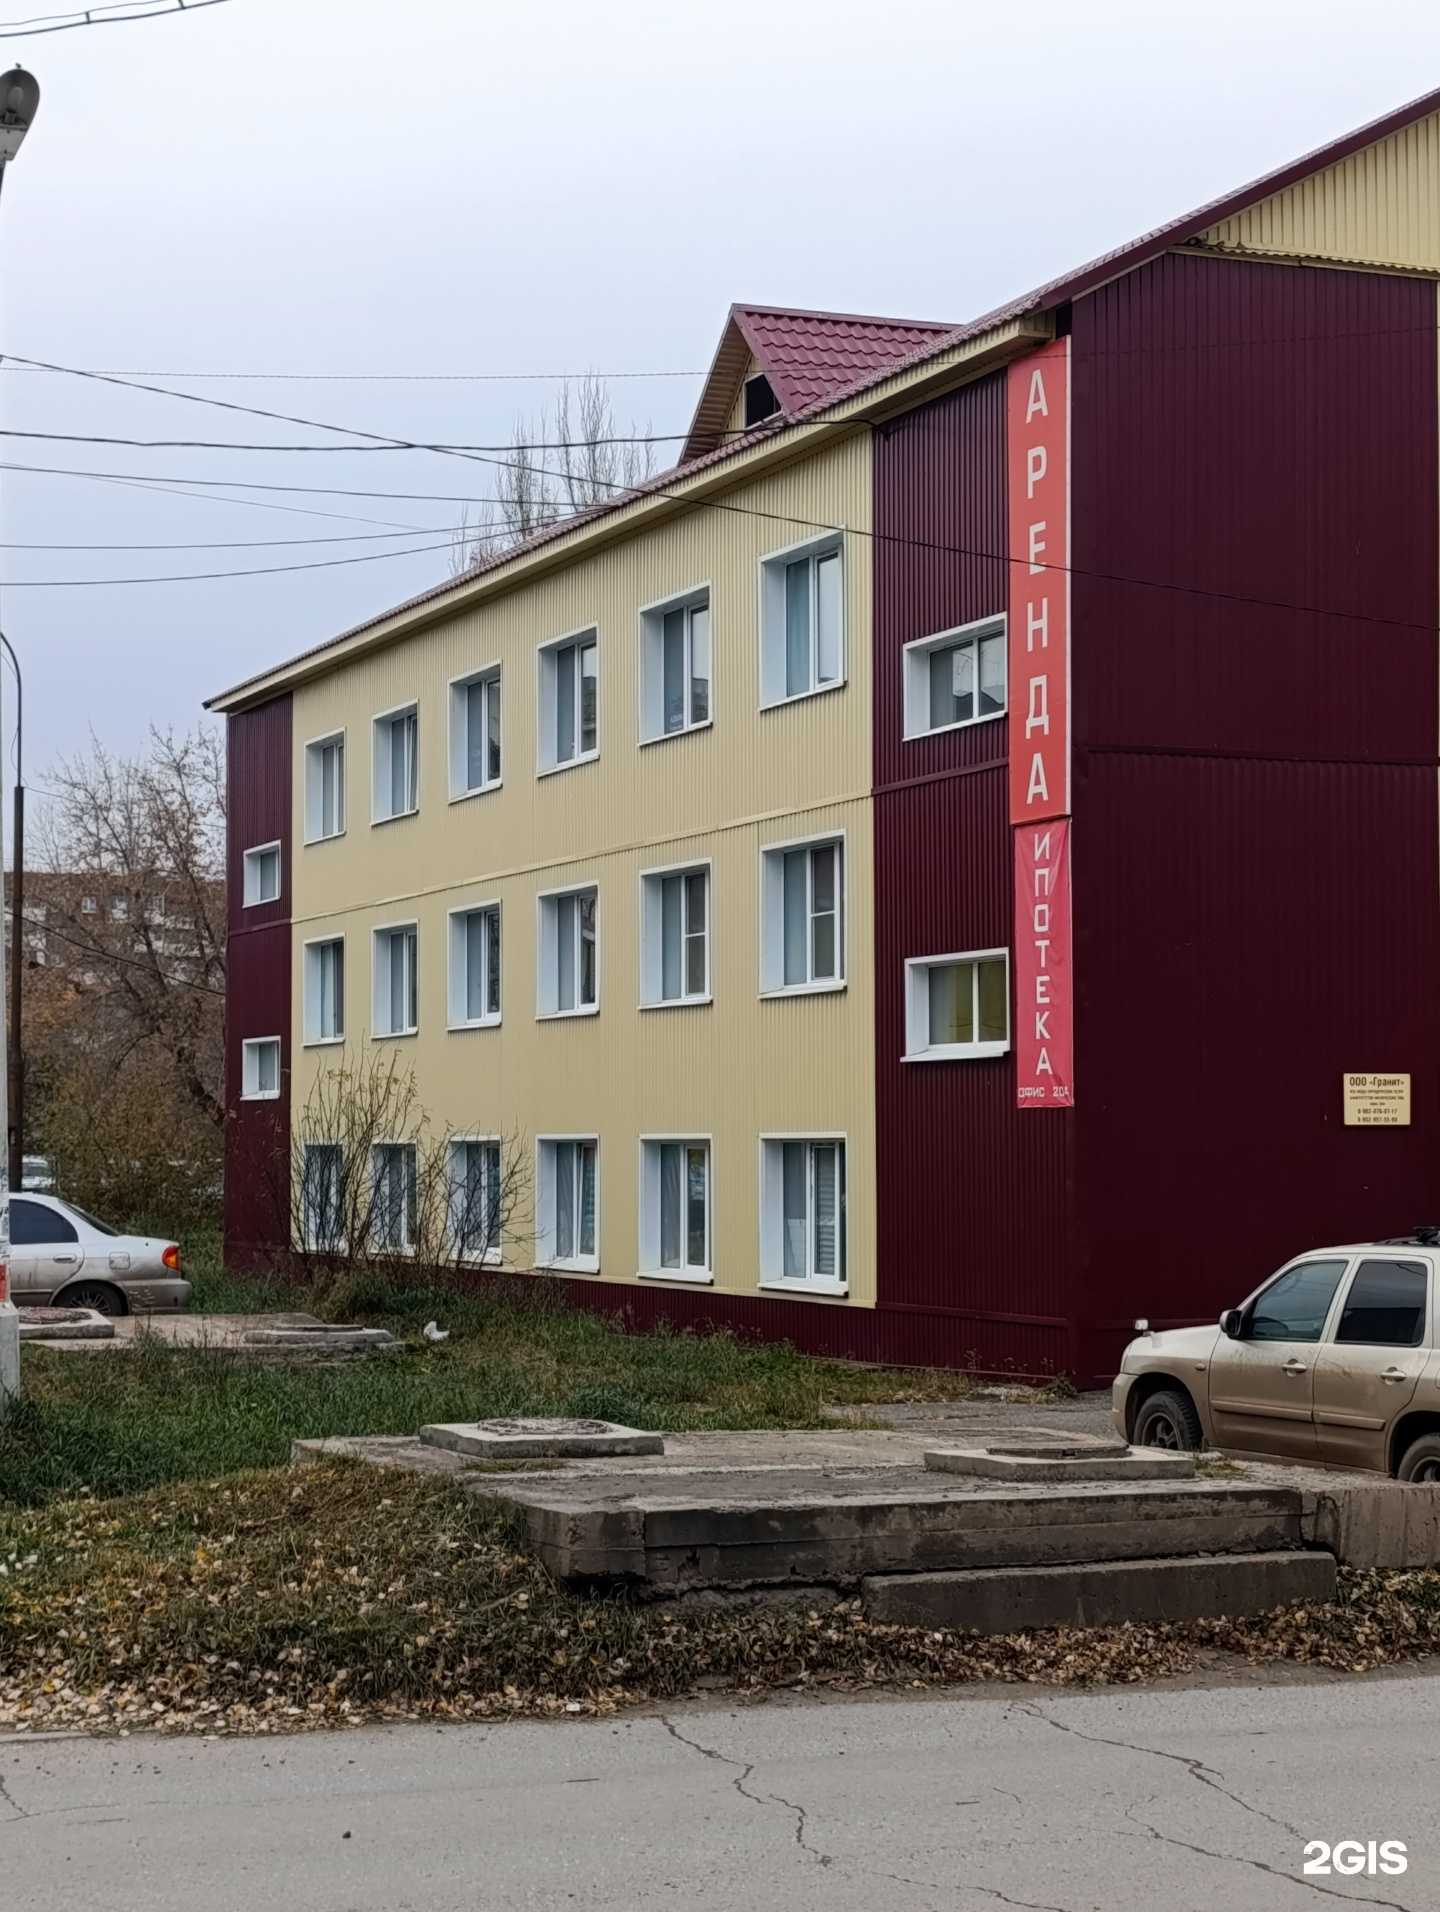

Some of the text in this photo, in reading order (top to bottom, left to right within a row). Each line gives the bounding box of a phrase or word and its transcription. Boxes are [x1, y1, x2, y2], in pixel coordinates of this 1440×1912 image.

[1025, 369, 1050, 805] АРЕНДА
[1034, 832, 1052, 1075] ИПОТЕКА
[1350, 1076, 1367, 1087] ООО
